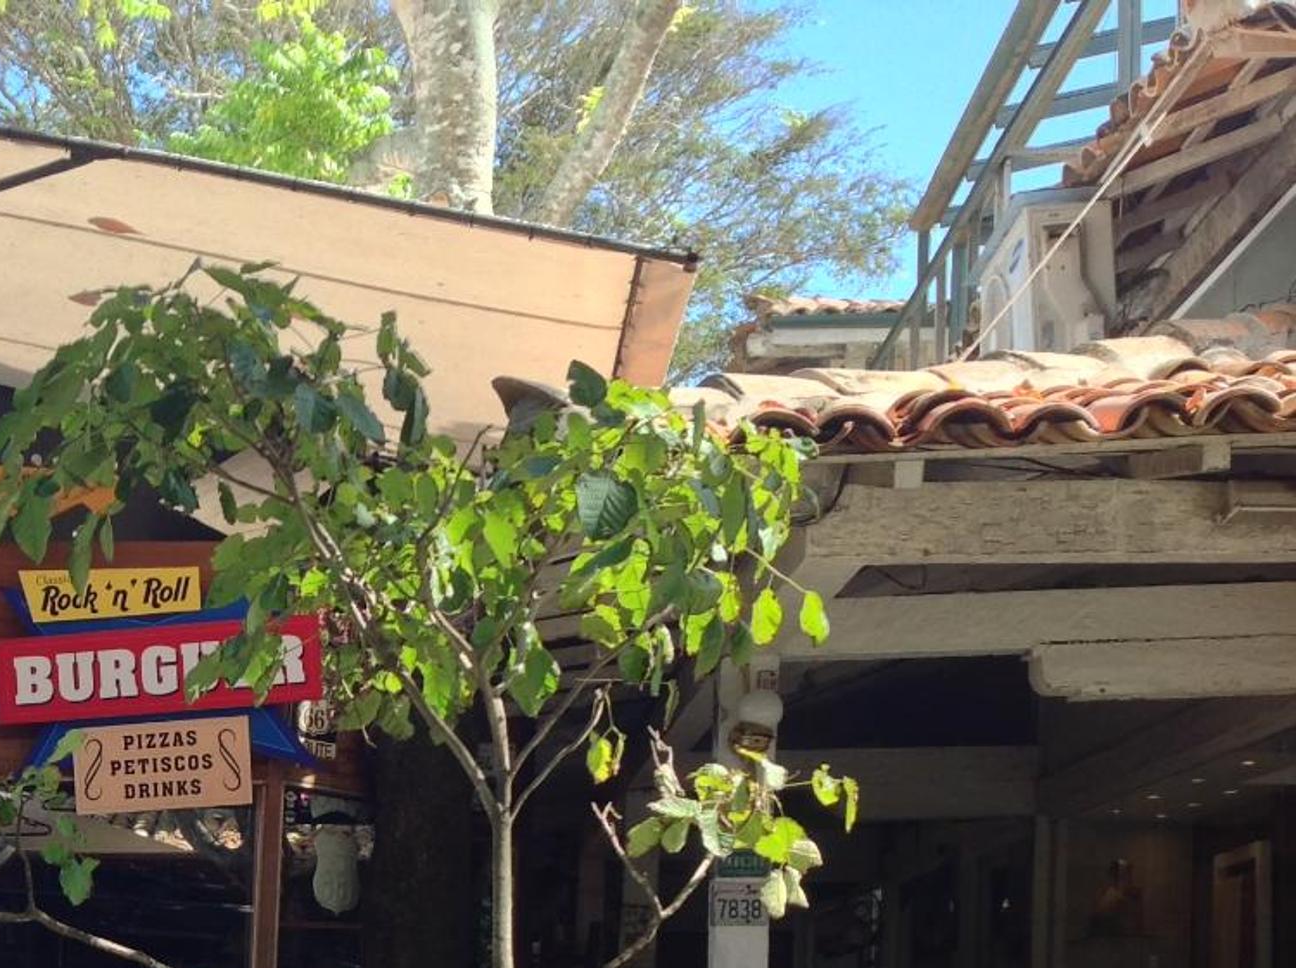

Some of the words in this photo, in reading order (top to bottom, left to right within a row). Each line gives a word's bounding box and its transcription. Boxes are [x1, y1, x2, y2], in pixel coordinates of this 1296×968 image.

[41, 585, 98, 616] Rock
[143, 576, 191, 608] Roll
[123, 730, 197, 750] PIZZAS
[110, 754, 213, 776] PETISCOS
[124, 779, 202, 799] DRINKS
[717, 898, 761, 920] 7838
